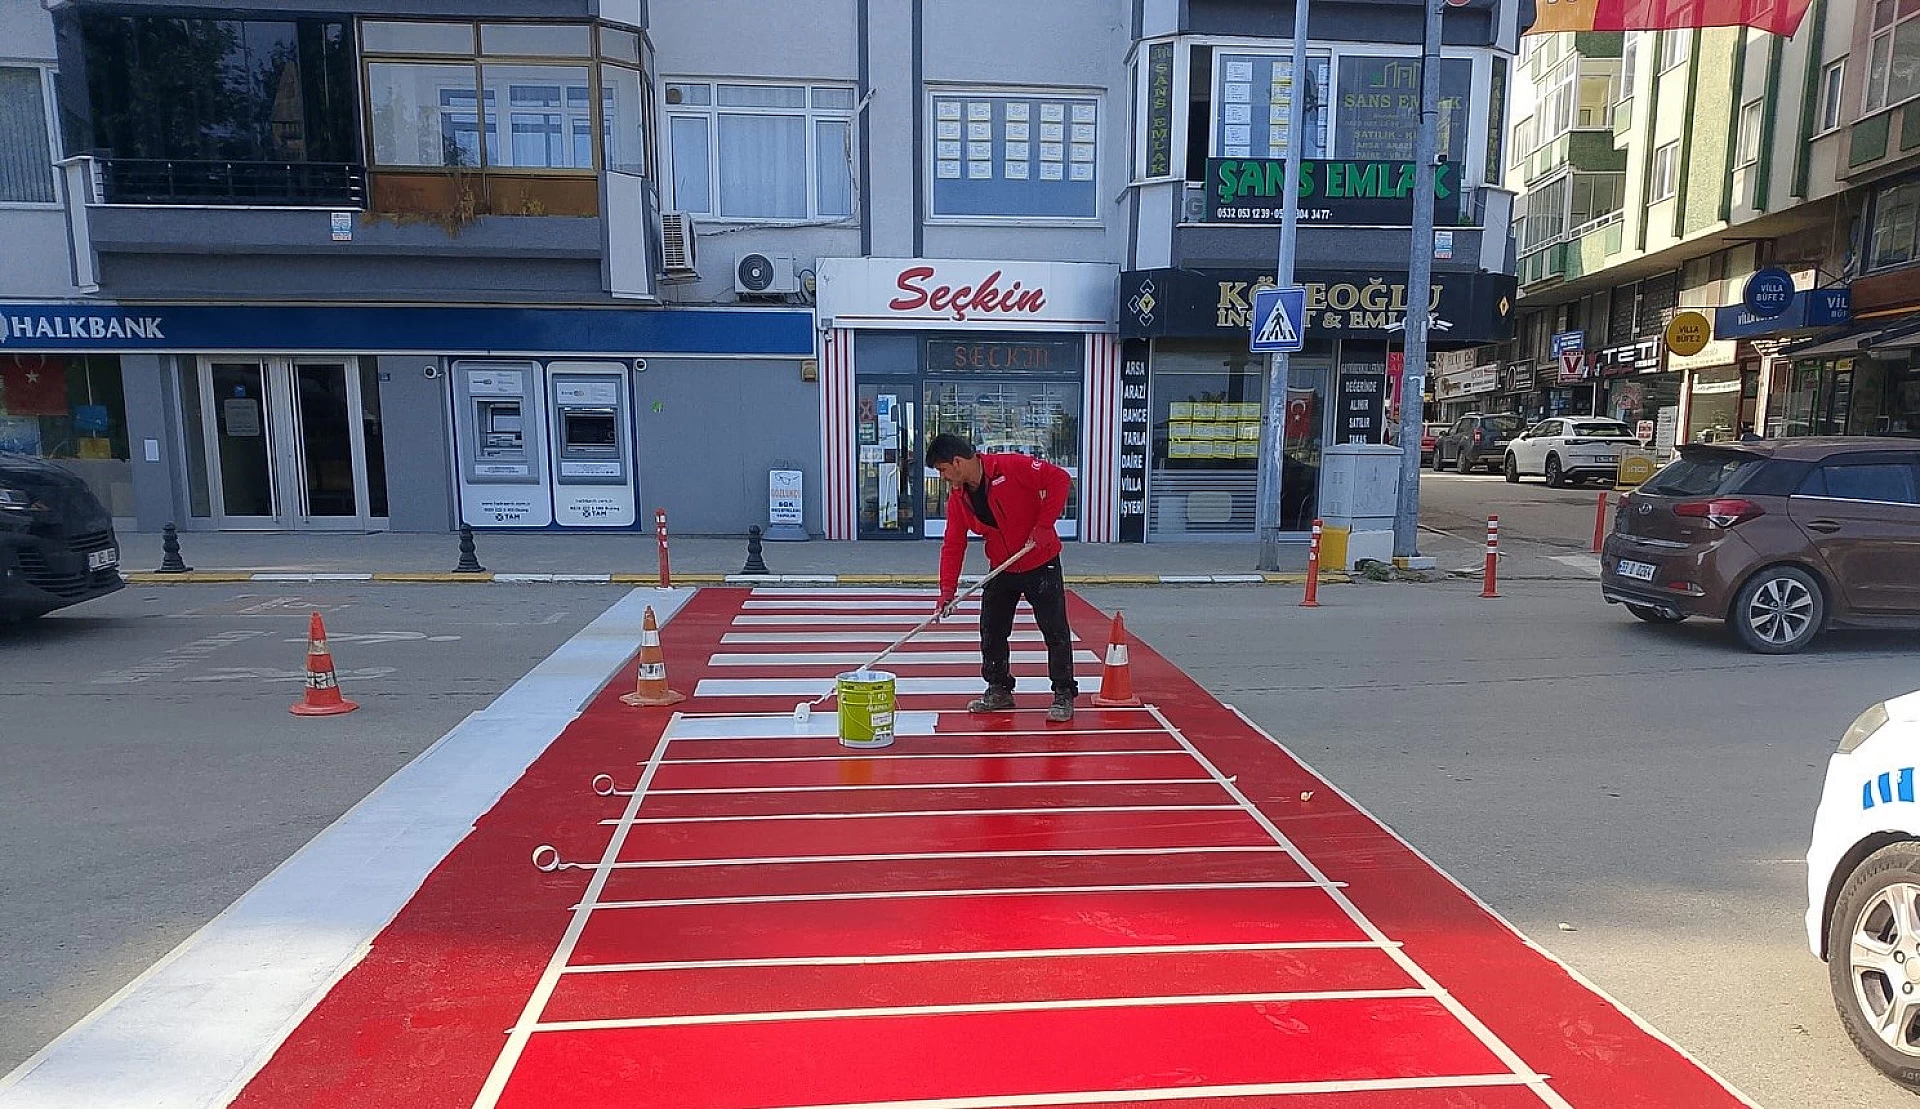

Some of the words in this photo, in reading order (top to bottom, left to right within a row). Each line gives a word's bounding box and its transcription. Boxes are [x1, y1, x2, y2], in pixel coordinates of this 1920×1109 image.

[1217, 159, 1316, 204] ŞANS
[888, 265, 1047, 322] Seçkin
[1760, 282, 1783, 292] VİLLA
[1755, 292, 1779, 301] BÜFE
[11, 316, 165, 339] HALKBANK
[1322, 312, 1342, 329] &
[1125, 360, 1145, 375] ARSA
[1124, 382, 1146, 400] ARAZİ
[1123, 431, 1146, 446] TARLA
[1121, 450, 1143, 469] DAİRE
[1121, 474, 1142, 492] VİLLA
